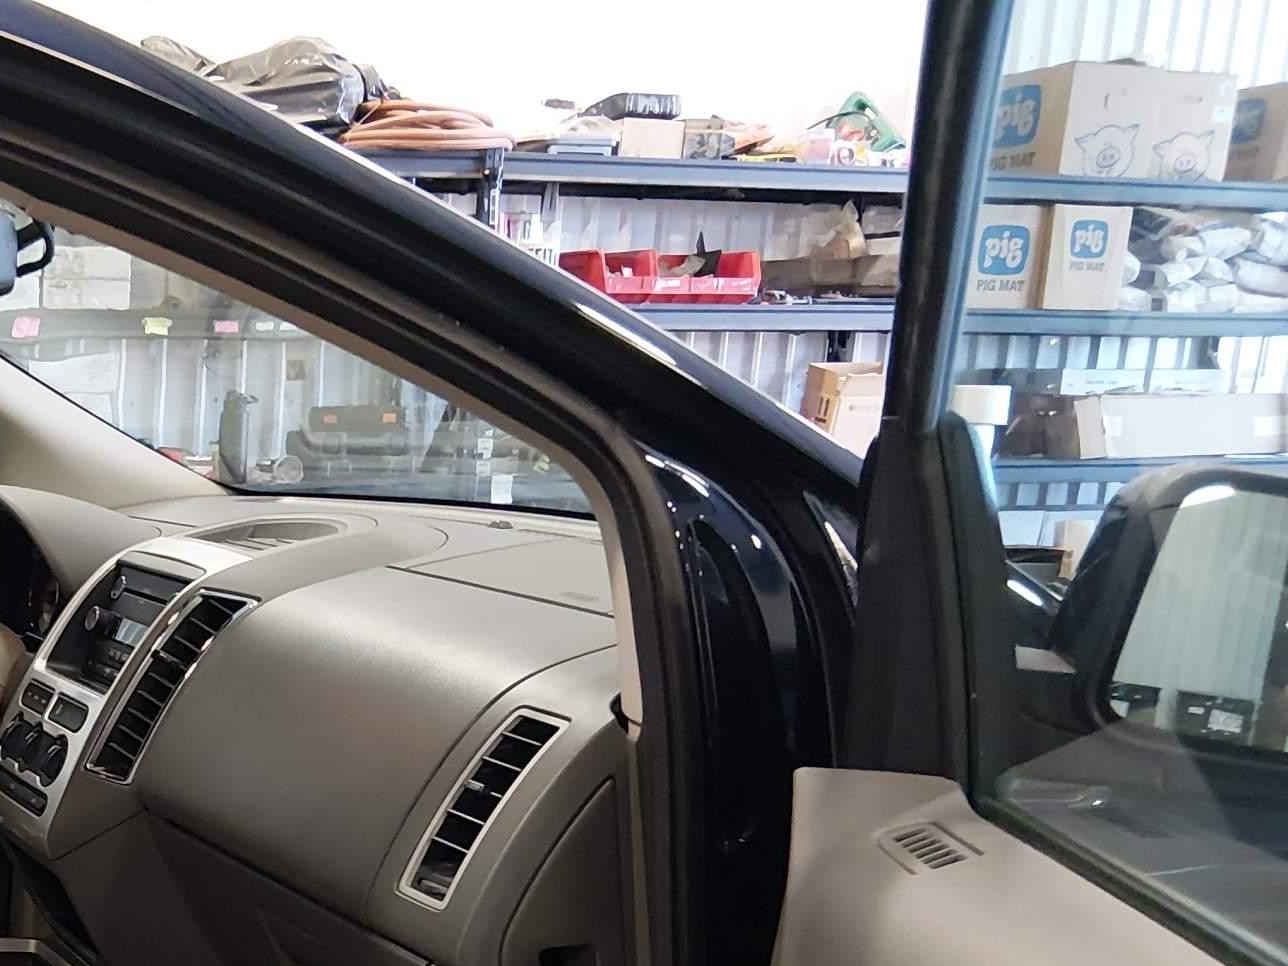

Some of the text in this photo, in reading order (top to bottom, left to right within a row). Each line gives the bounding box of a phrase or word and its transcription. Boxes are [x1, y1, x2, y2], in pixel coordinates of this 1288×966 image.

[983, 230, 1024, 268] pig
[1075, 224, 1104, 253] pig
[1070, 261, 1105, 271] PIG MAT
[976, 279, 1025, 292] PIG MAT
